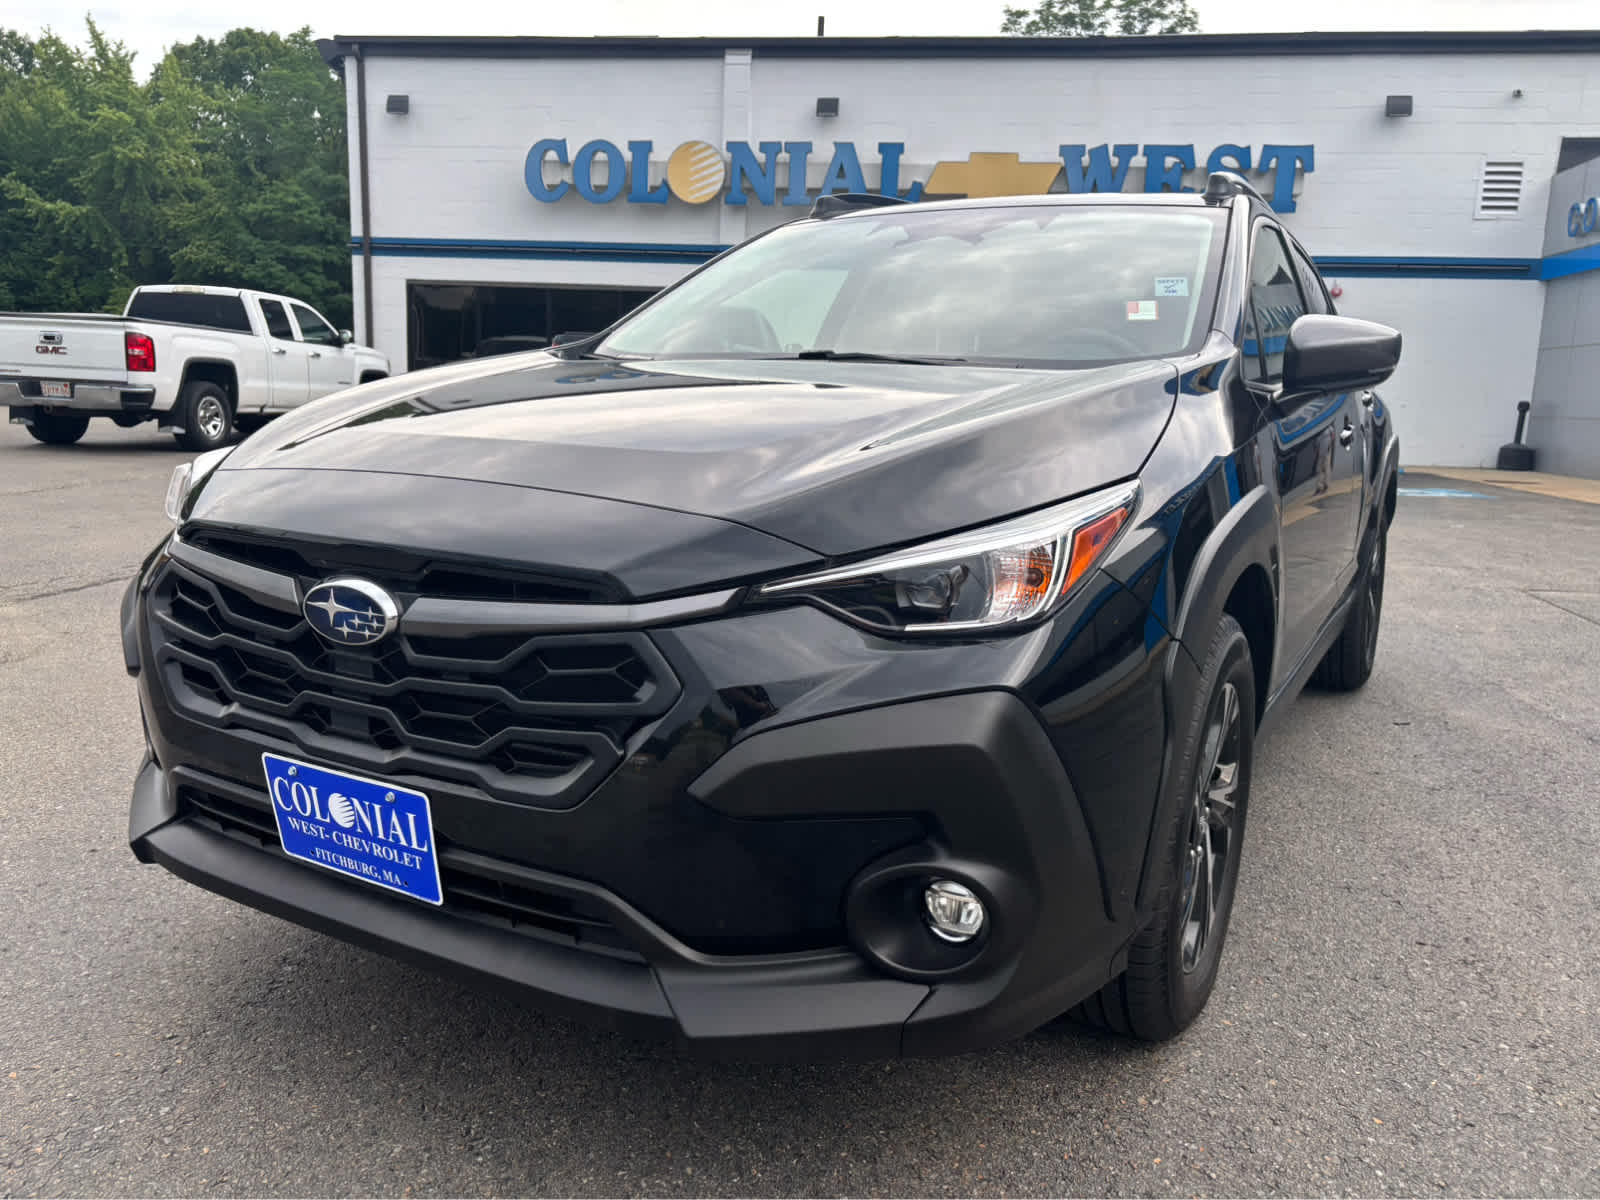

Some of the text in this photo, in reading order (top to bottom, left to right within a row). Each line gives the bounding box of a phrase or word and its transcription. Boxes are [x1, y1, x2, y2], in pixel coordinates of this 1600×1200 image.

[525, 138, 921, 206] COLONIAL
[35, 345, 67, 355] GMC
[273, 776, 428, 852] COLONIAL
[332, 830, 423, 870] CHEVROLET
